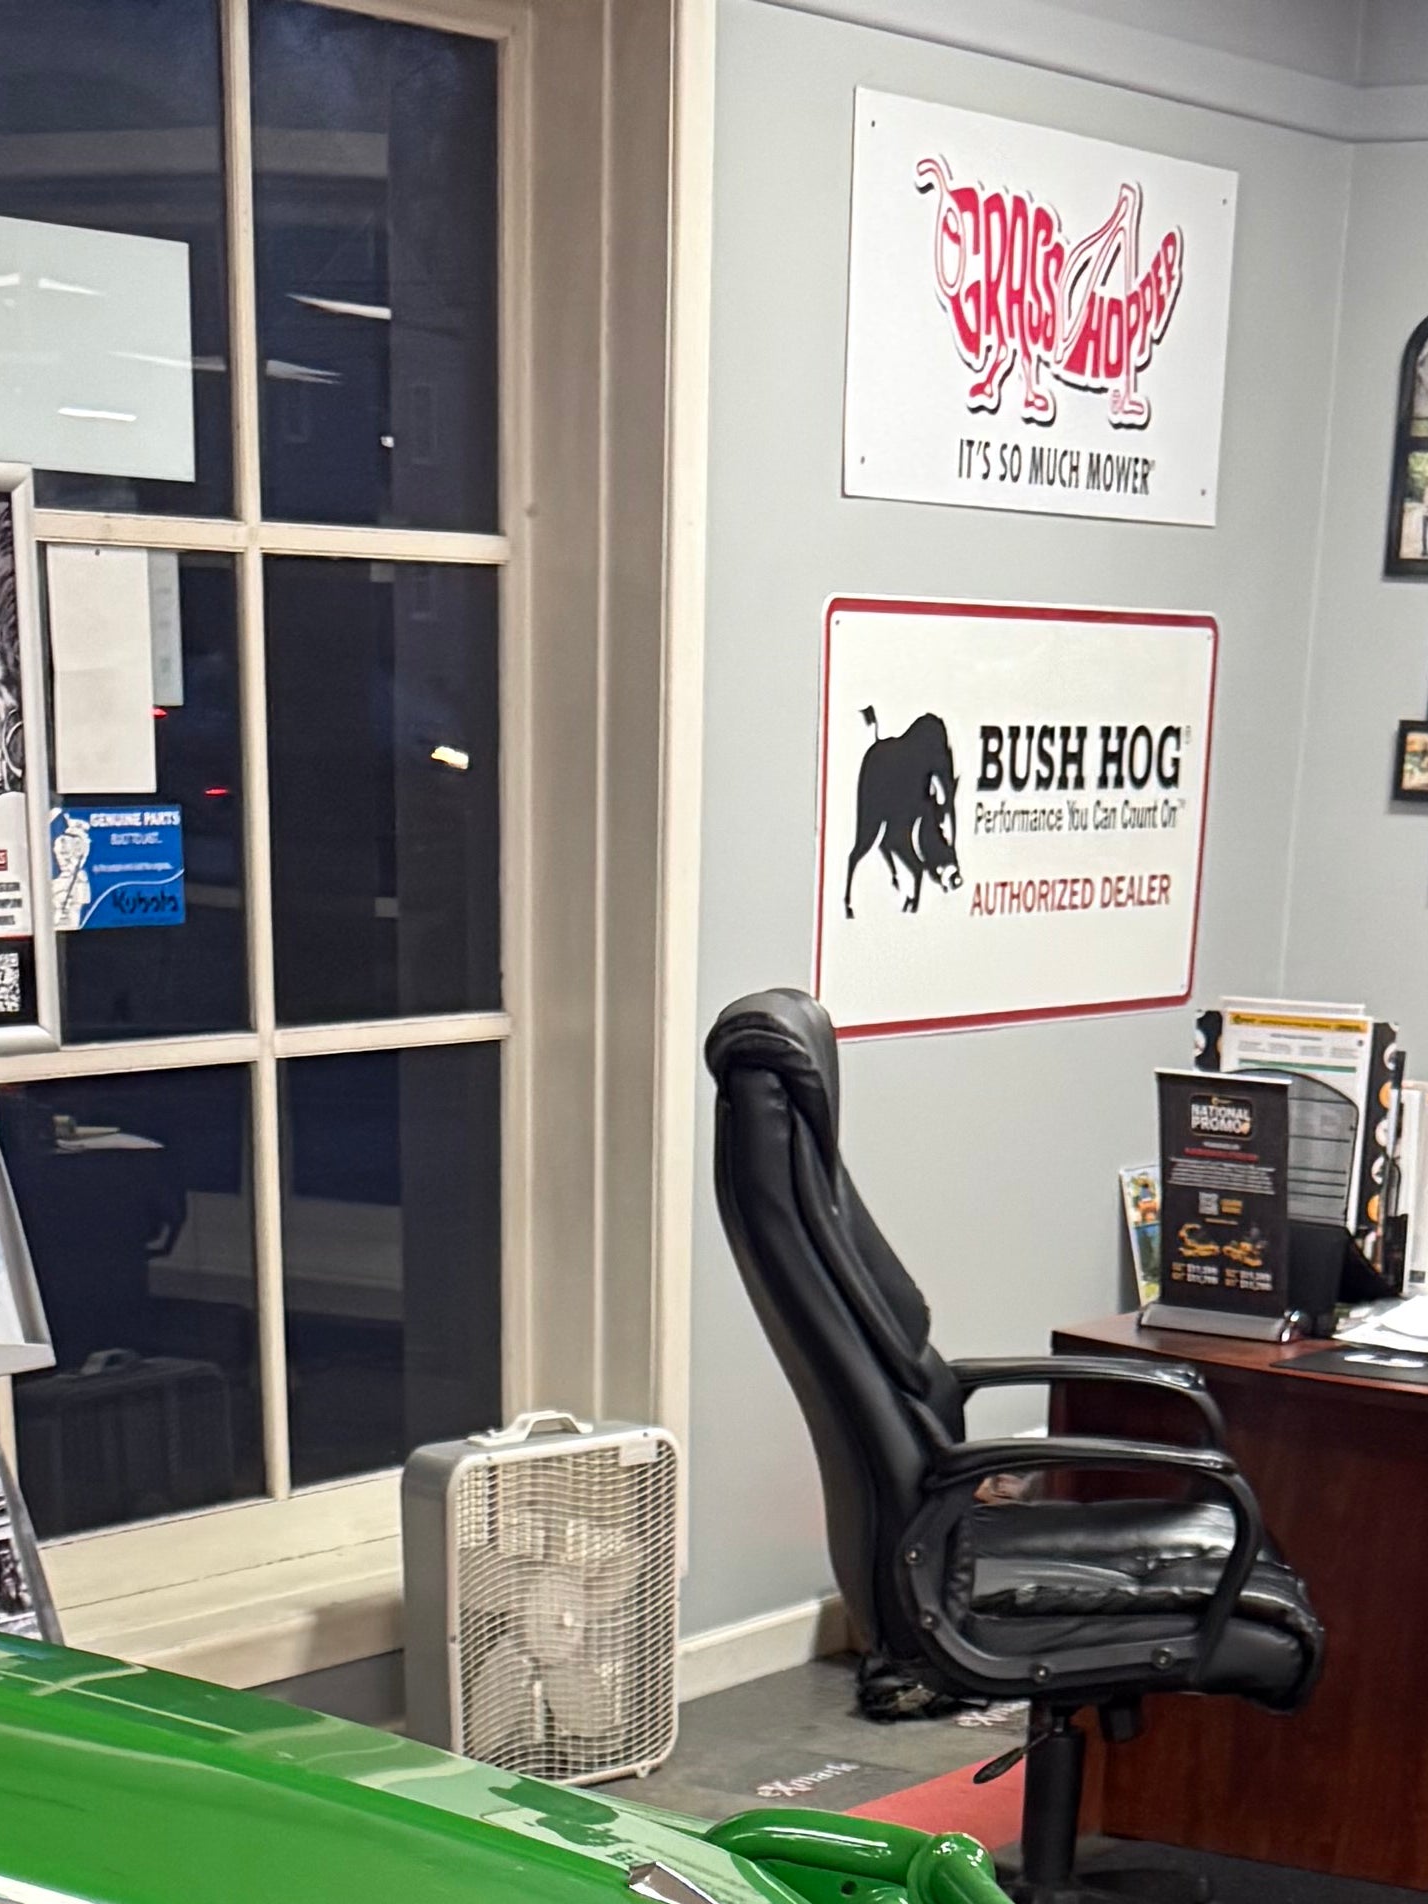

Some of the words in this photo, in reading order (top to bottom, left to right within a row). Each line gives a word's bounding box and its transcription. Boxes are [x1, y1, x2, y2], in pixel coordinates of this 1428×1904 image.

[958, 438, 991, 479] IT'S
[999, 443, 1022, 482] SO
[1029, 446, 1081, 489] MUCH
[1086, 452, 1151, 496] MOWER
[977, 724, 1087, 792] BUSH
[1097, 724, 1182, 789] HOG
[974, 802, 1063, 834] Performance
[1067, 803, 1088, 832] You
[1093, 801, 1117, 830] Can
[1121, 799, 1156, 829] Count
[1161, 800, 1177, 829] On
[971, 877, 1095, 918] AUTHORIZED
[1100, 874, 1171, 910] DEALER
